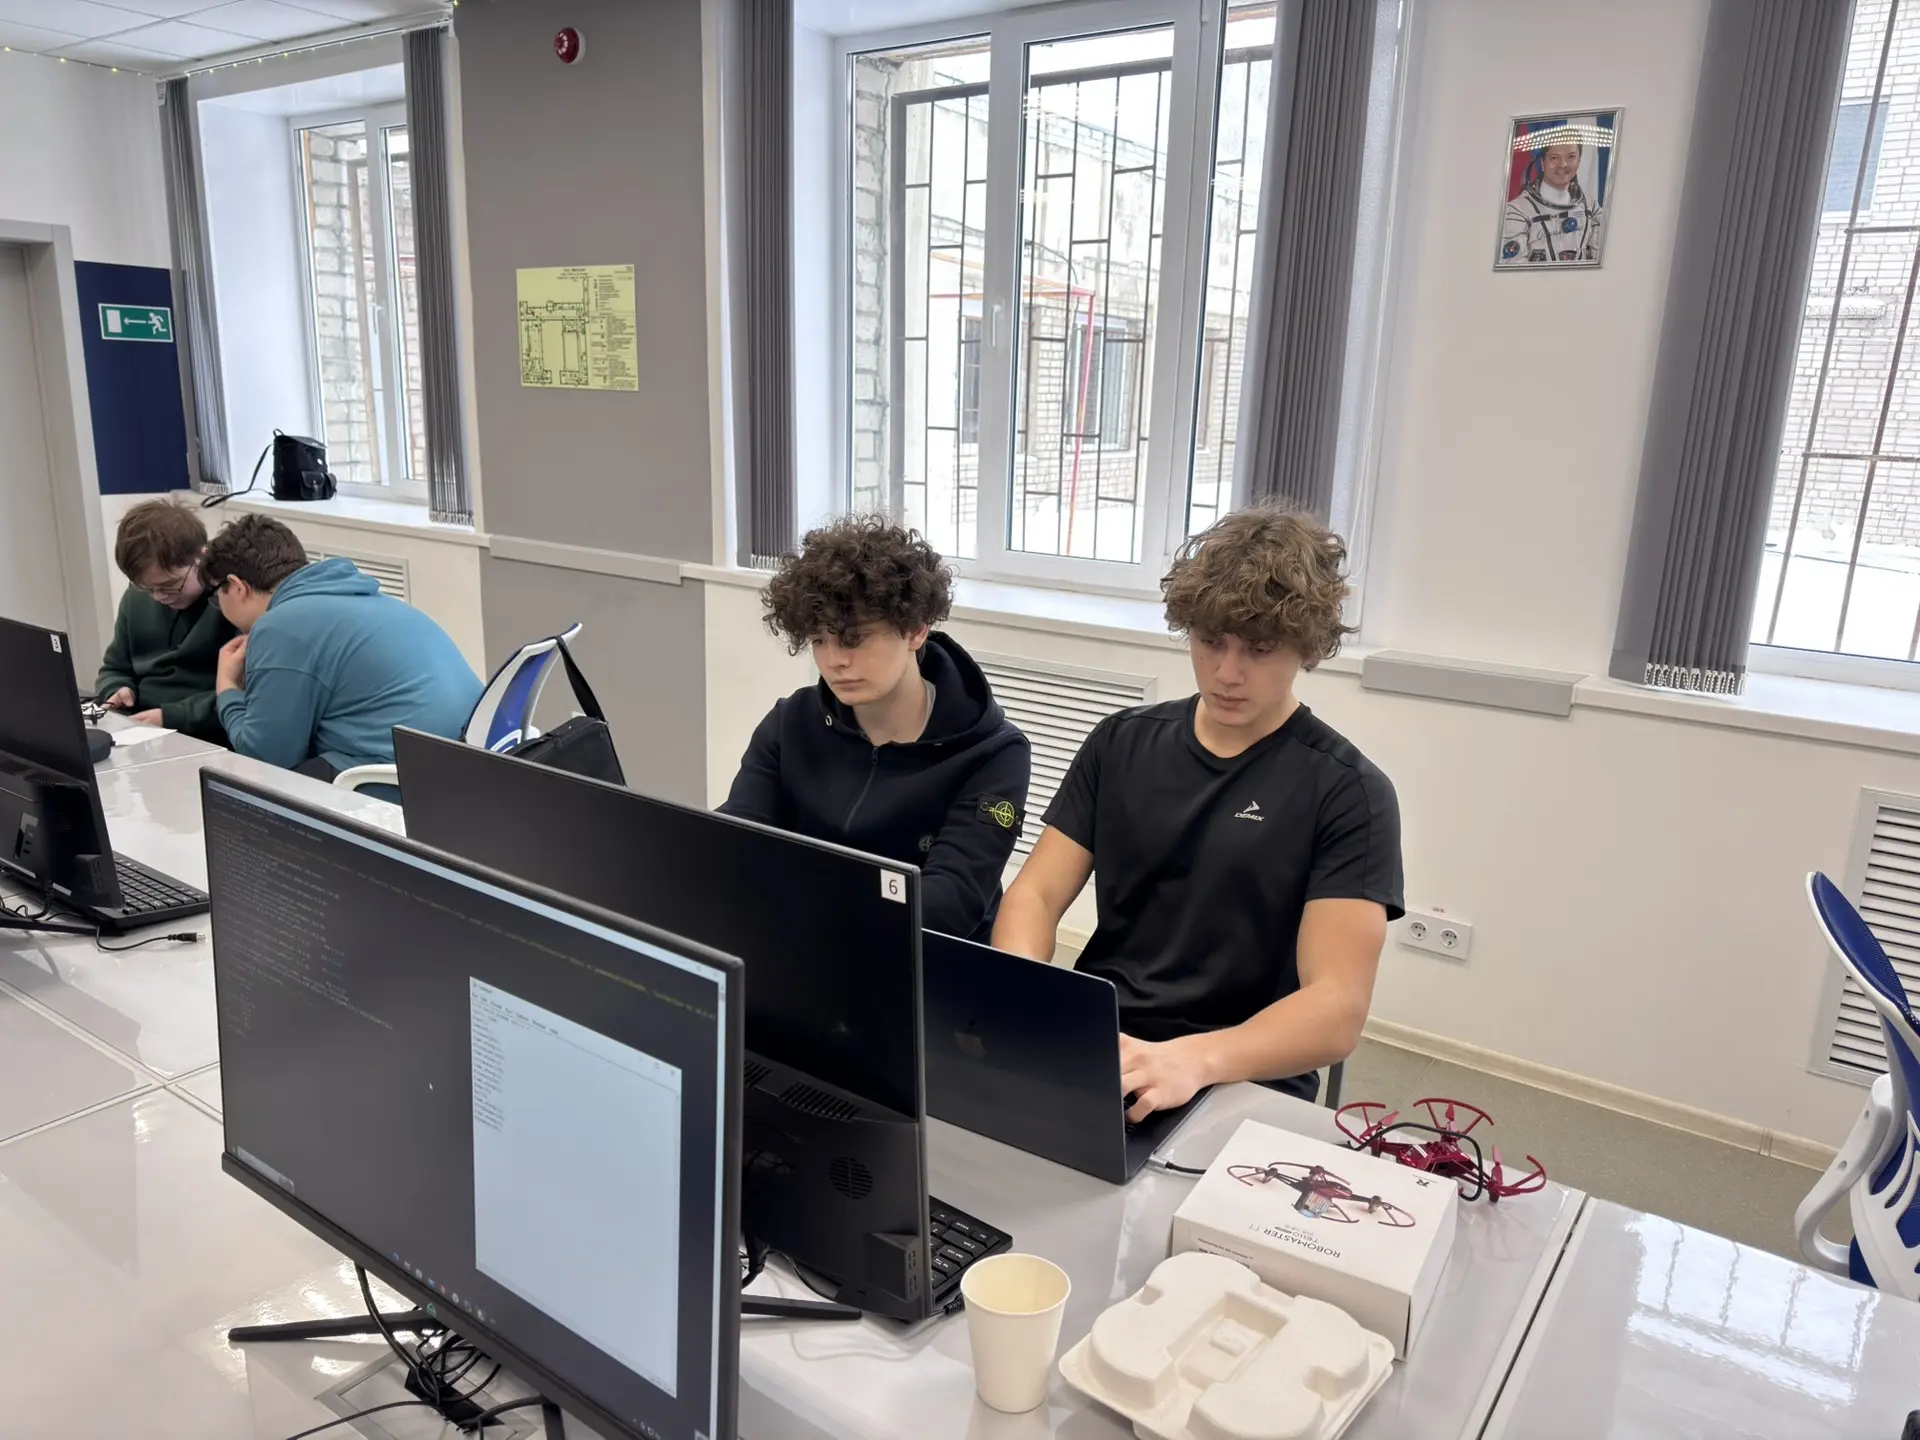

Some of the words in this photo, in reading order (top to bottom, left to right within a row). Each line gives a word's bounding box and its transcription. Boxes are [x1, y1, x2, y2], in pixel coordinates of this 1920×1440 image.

[1234, 812, 1265, 822] DEMIX
[888, 879, 898, 895] 6
[1263, 1227, 1341, 1258] ROBOMASTER
